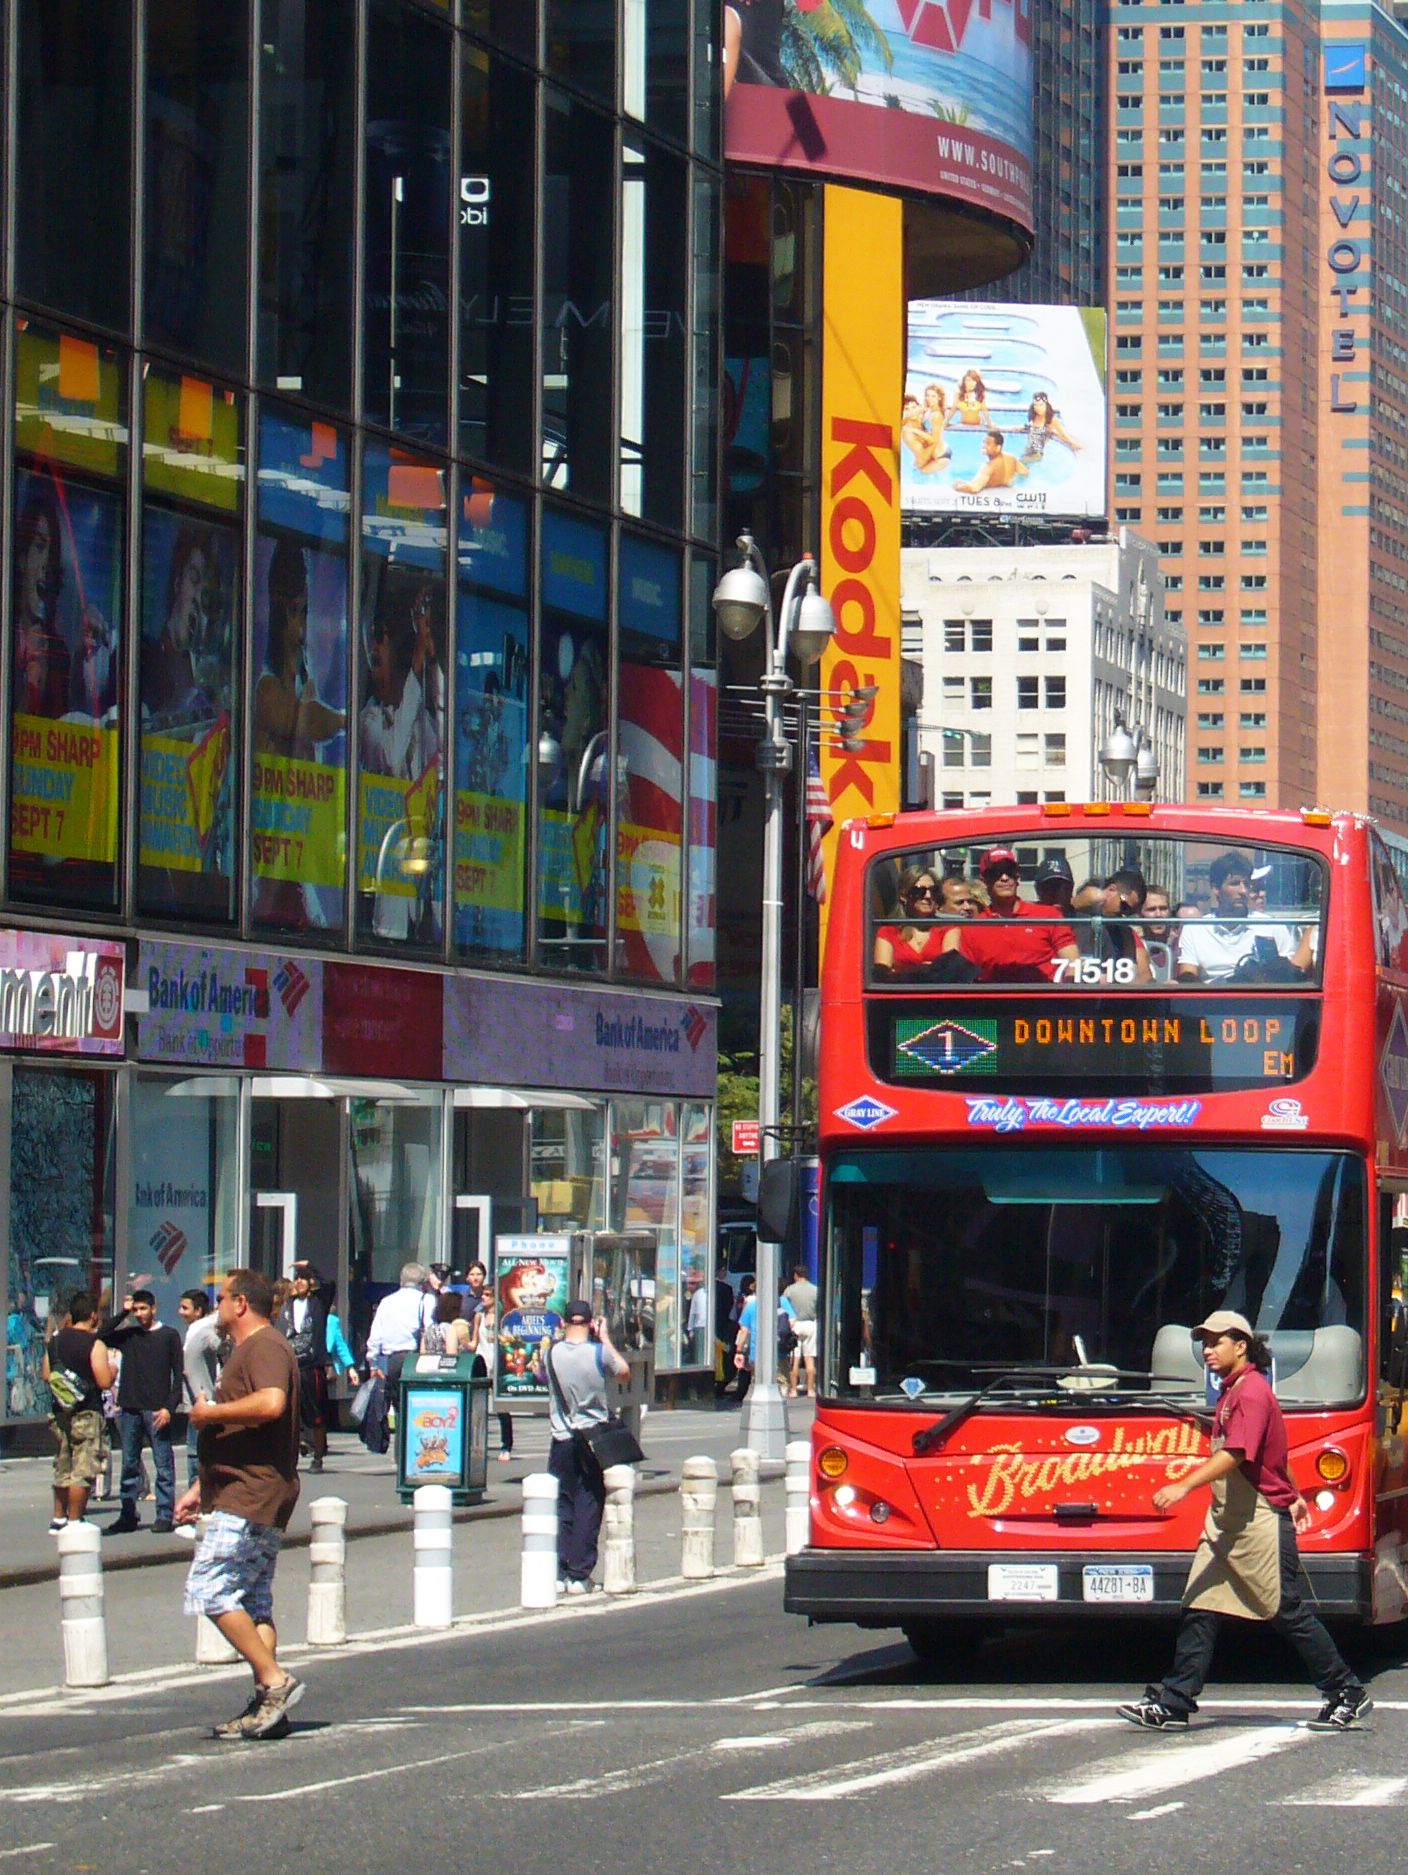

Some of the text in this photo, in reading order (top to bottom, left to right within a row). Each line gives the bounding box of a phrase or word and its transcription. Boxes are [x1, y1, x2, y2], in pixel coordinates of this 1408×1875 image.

[1327, 101, 1361, 413] NOVOTEL
[961, 495, 990, 506] TUES
[830, 415, 893, 809] Kodak
[47, 730, 101, 768] SHARP
[286, 763, 335, 802] SHARP
[53, 809, 65, 842] 7
[295, 841, 304, 869] 7
[1050, 957, 1135, 984] 71518
[149, 965, 189, 1010] Bank
[190, 969, 207, 1013] of
[596, 1012, 680, 1052] Bank of America
[937, 1018, 1280, 1061] 1 DOWNTOWN LOOP
[844, 1106, 886, 1119] GRAY LINE
[967, 1098, 1200, 1131] Truly, The Local Expert!
[511, 1239, 555, 1249] Phone
[512, 1324, 553, 1336] BEGINNING
[966, 1423, 1213, 1518] Broadway
